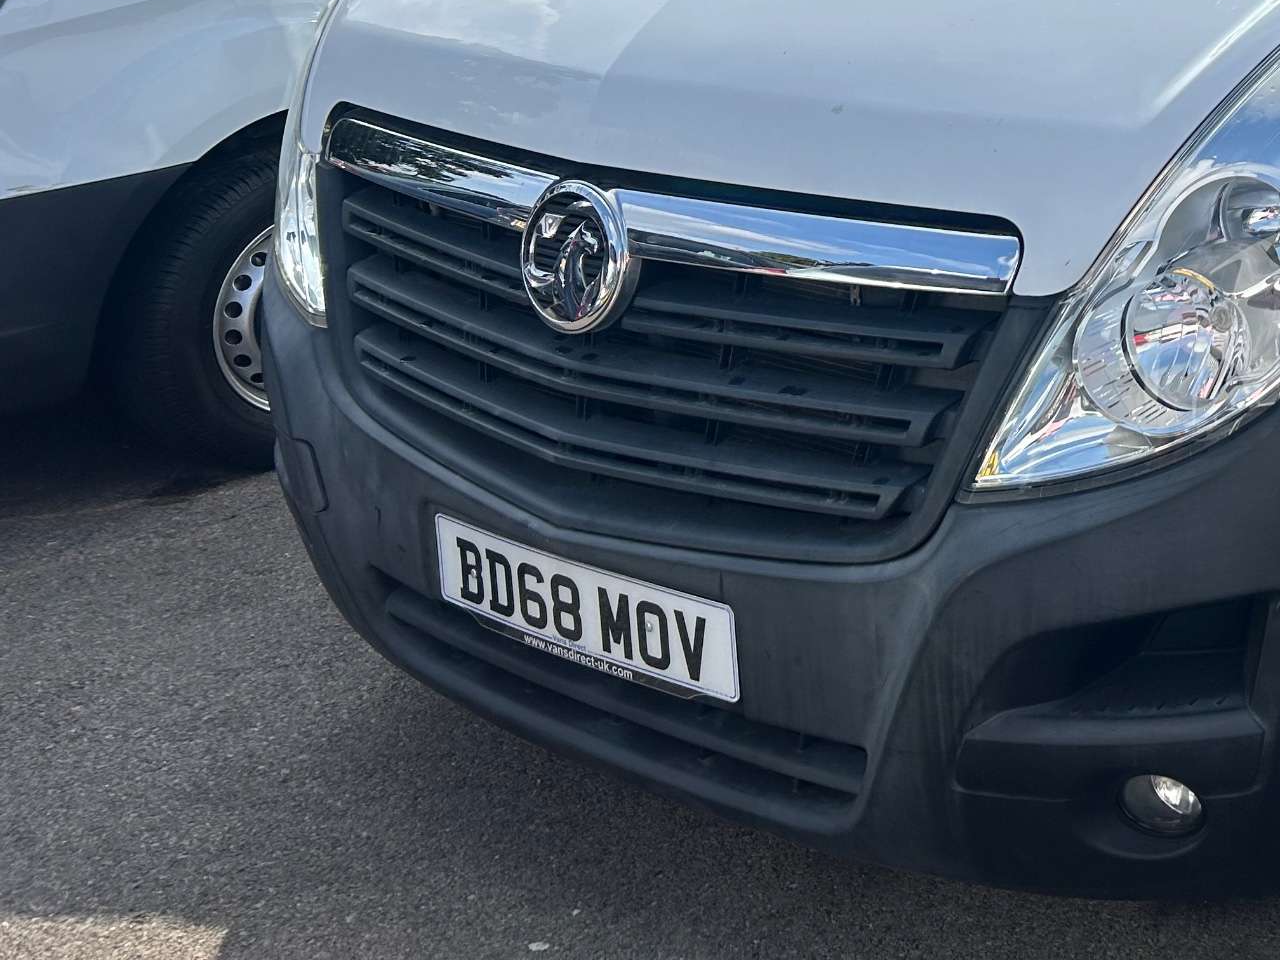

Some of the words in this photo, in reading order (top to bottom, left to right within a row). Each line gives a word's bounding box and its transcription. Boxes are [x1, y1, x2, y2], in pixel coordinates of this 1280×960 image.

[456, 536, 583, 641] BD68
[597, 586, 707, 682] MOV
[523, 634, 633, 680] www.vansdirect-uk.com
